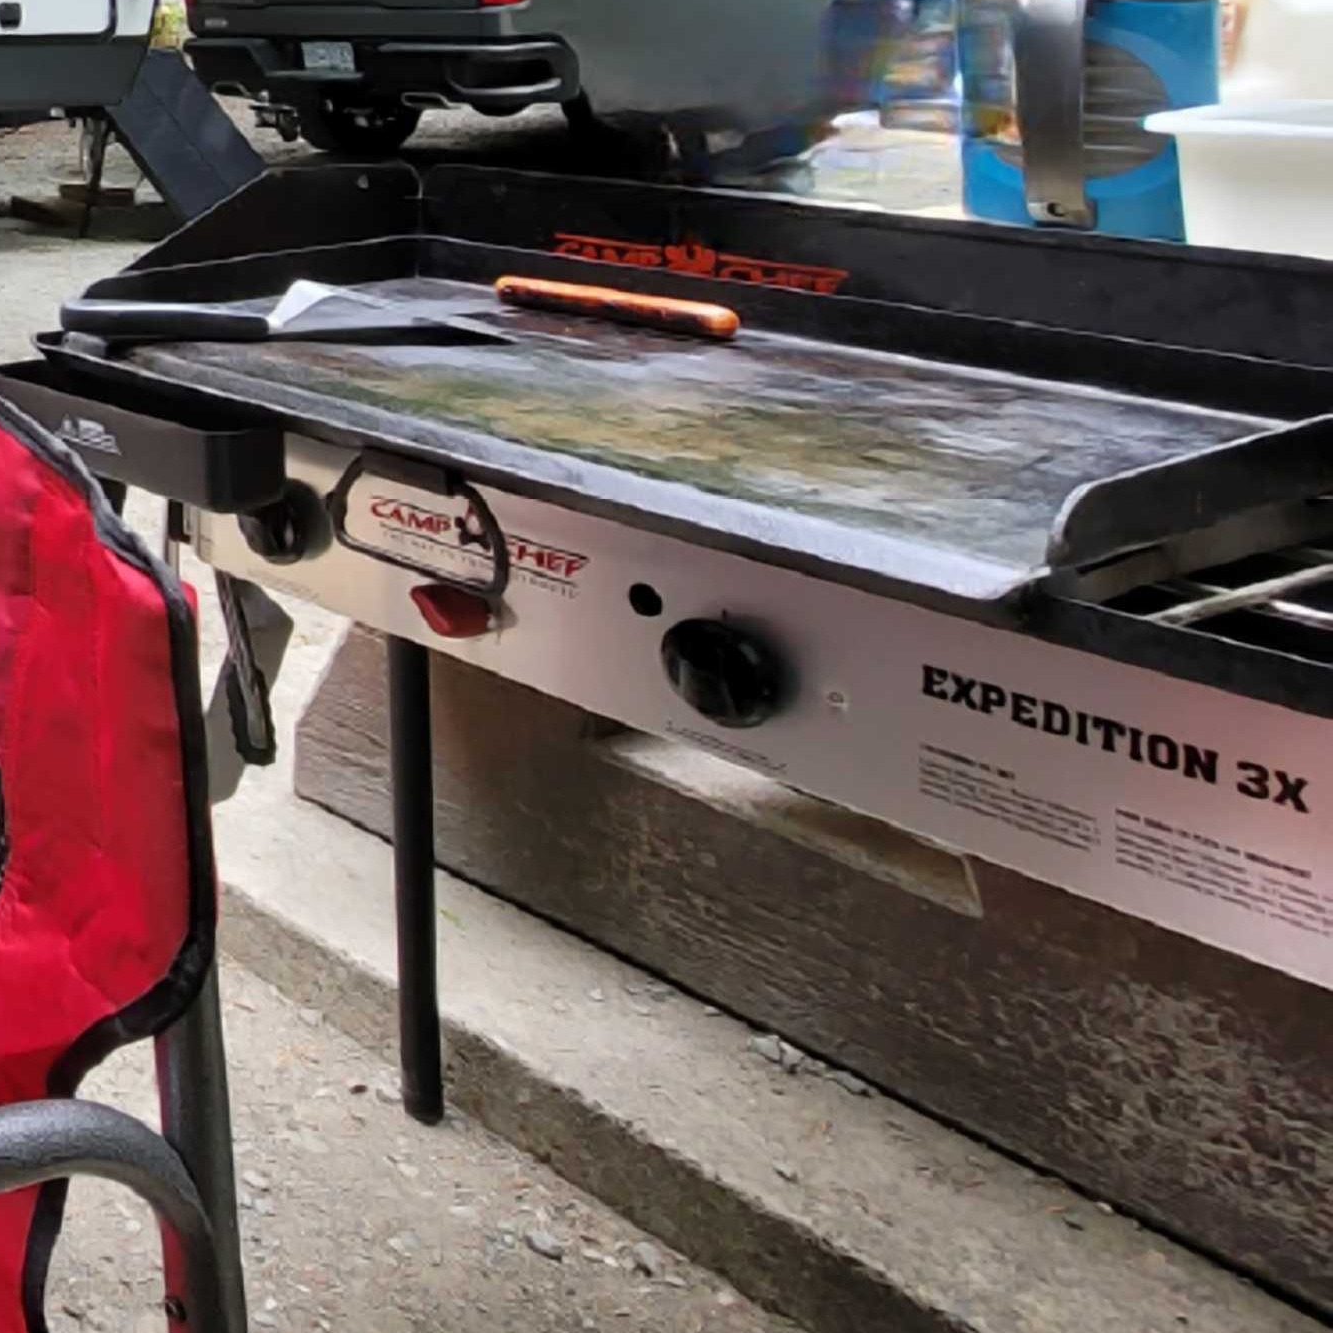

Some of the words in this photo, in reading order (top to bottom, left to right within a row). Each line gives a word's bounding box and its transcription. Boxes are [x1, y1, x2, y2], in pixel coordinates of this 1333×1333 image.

[370, 498, 452, 535] CAMP
[921, 664, 1220, 784] EXPEDITION
[1235, 760, 1310, 814] 3X
